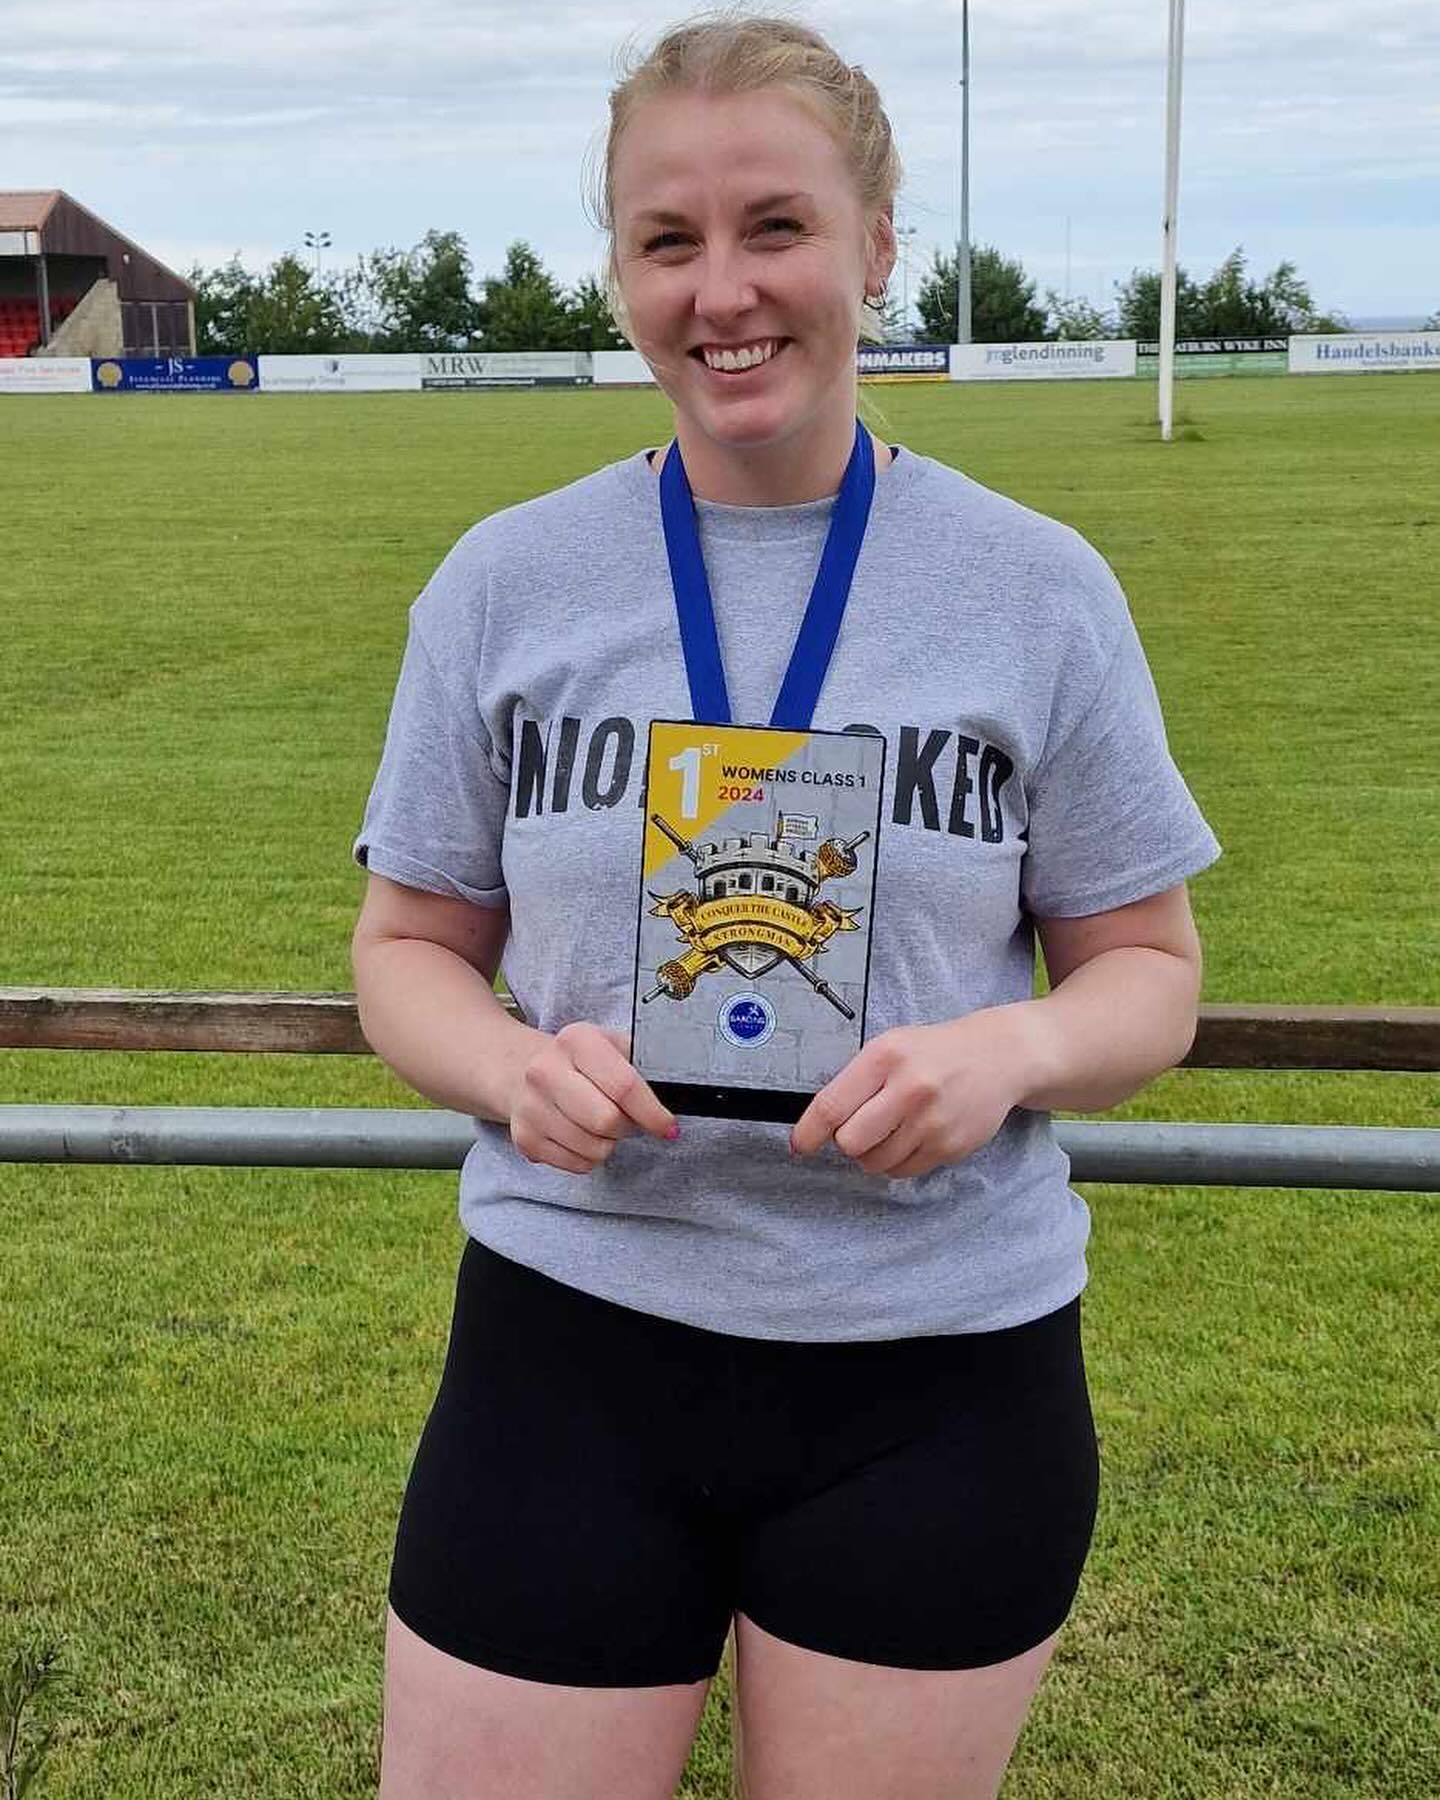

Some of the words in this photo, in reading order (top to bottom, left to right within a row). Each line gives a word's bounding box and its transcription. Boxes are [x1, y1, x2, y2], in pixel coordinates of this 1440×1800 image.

[428, 357, 485, 375] MRW
[858, 352, 946, 367] NMAKERS
[722, 766, 798, 783] WOMENS
[802, 771, 855, 787] CLASS
[857, 776, 866, 788] 1
[718, 786, 765, 801] 2024
[713, 927, 790, 945] STRONGMAN
